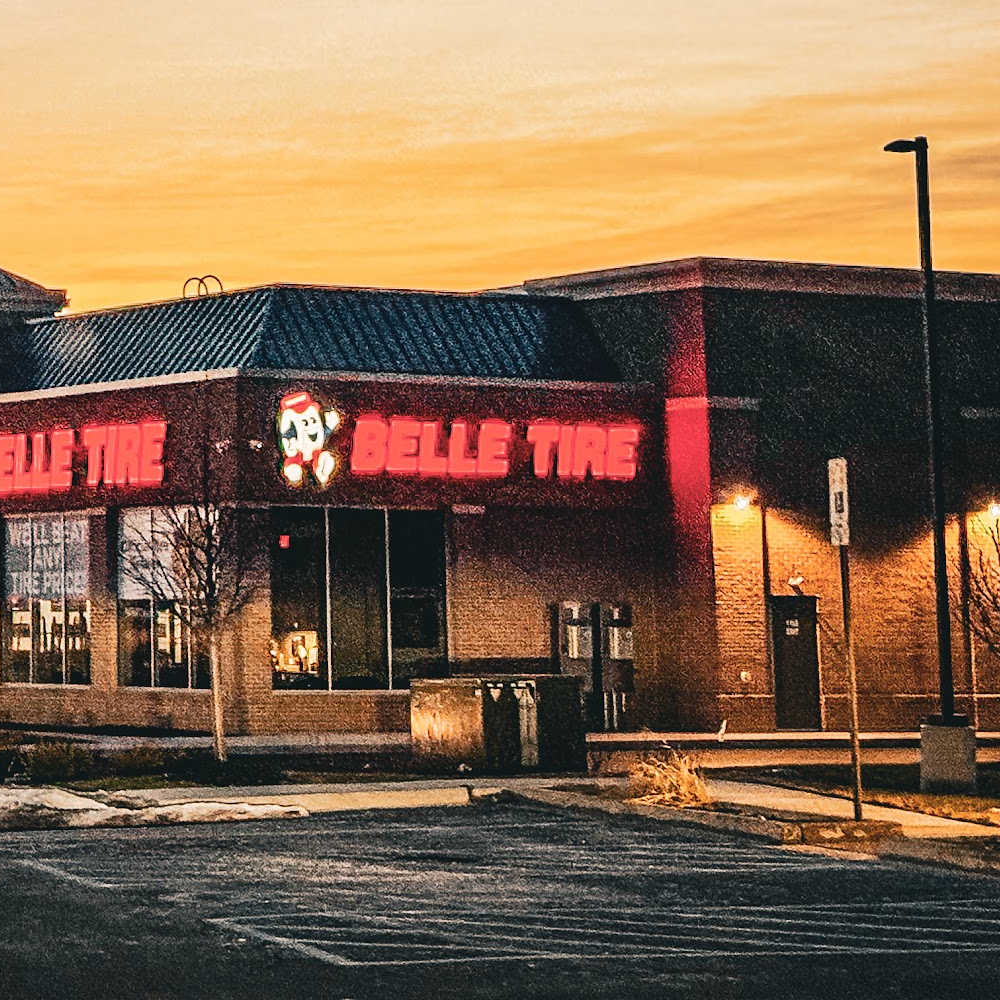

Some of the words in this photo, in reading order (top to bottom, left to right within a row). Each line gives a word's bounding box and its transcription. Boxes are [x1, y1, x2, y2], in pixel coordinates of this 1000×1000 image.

[83, 421, 166, 485] TIRE
[350, 419, 511, 474] BELLE
[527, 424, 639, 478] TIRE
